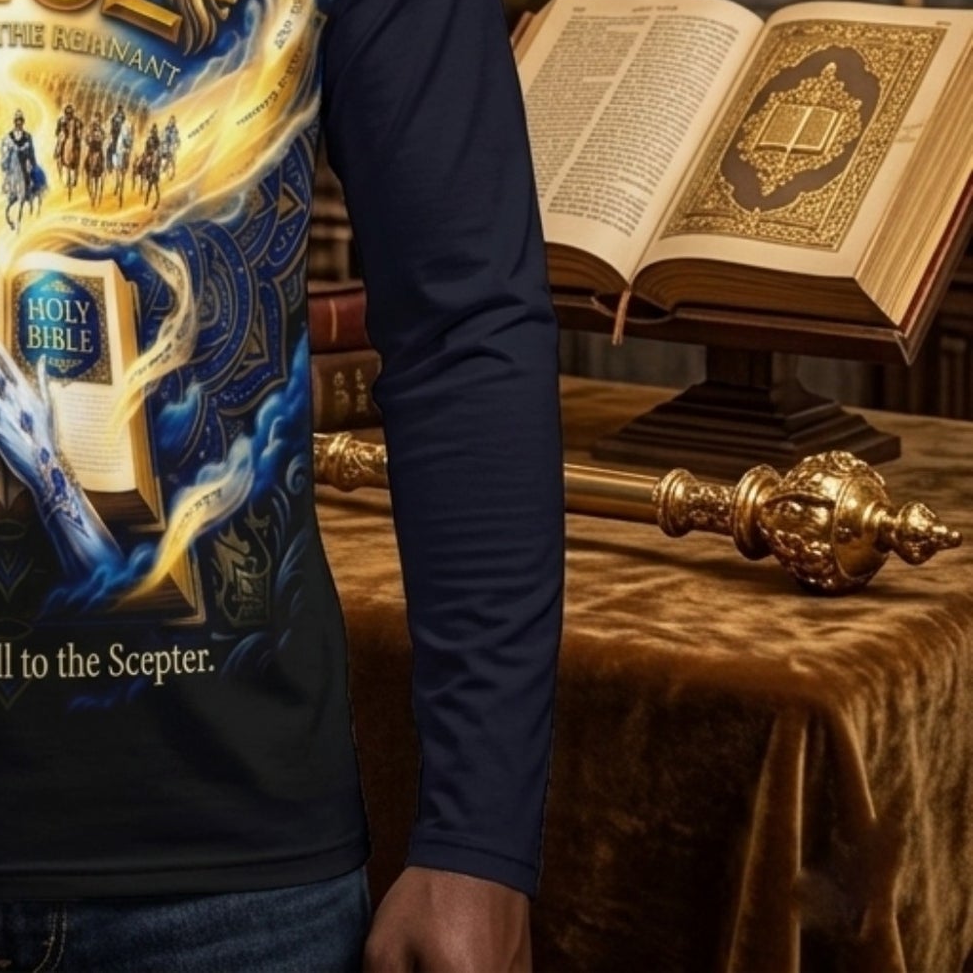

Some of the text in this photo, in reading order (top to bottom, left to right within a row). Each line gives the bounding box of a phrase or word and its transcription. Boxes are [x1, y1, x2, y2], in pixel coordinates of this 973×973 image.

[27, 297, 90, 325] HOLY
[27, 324, 94, 353] BIBLE
[21, 650, 48, 679] to
[57, 643, 100, 678] the
[109, 643, 214, 685] Scepter.
